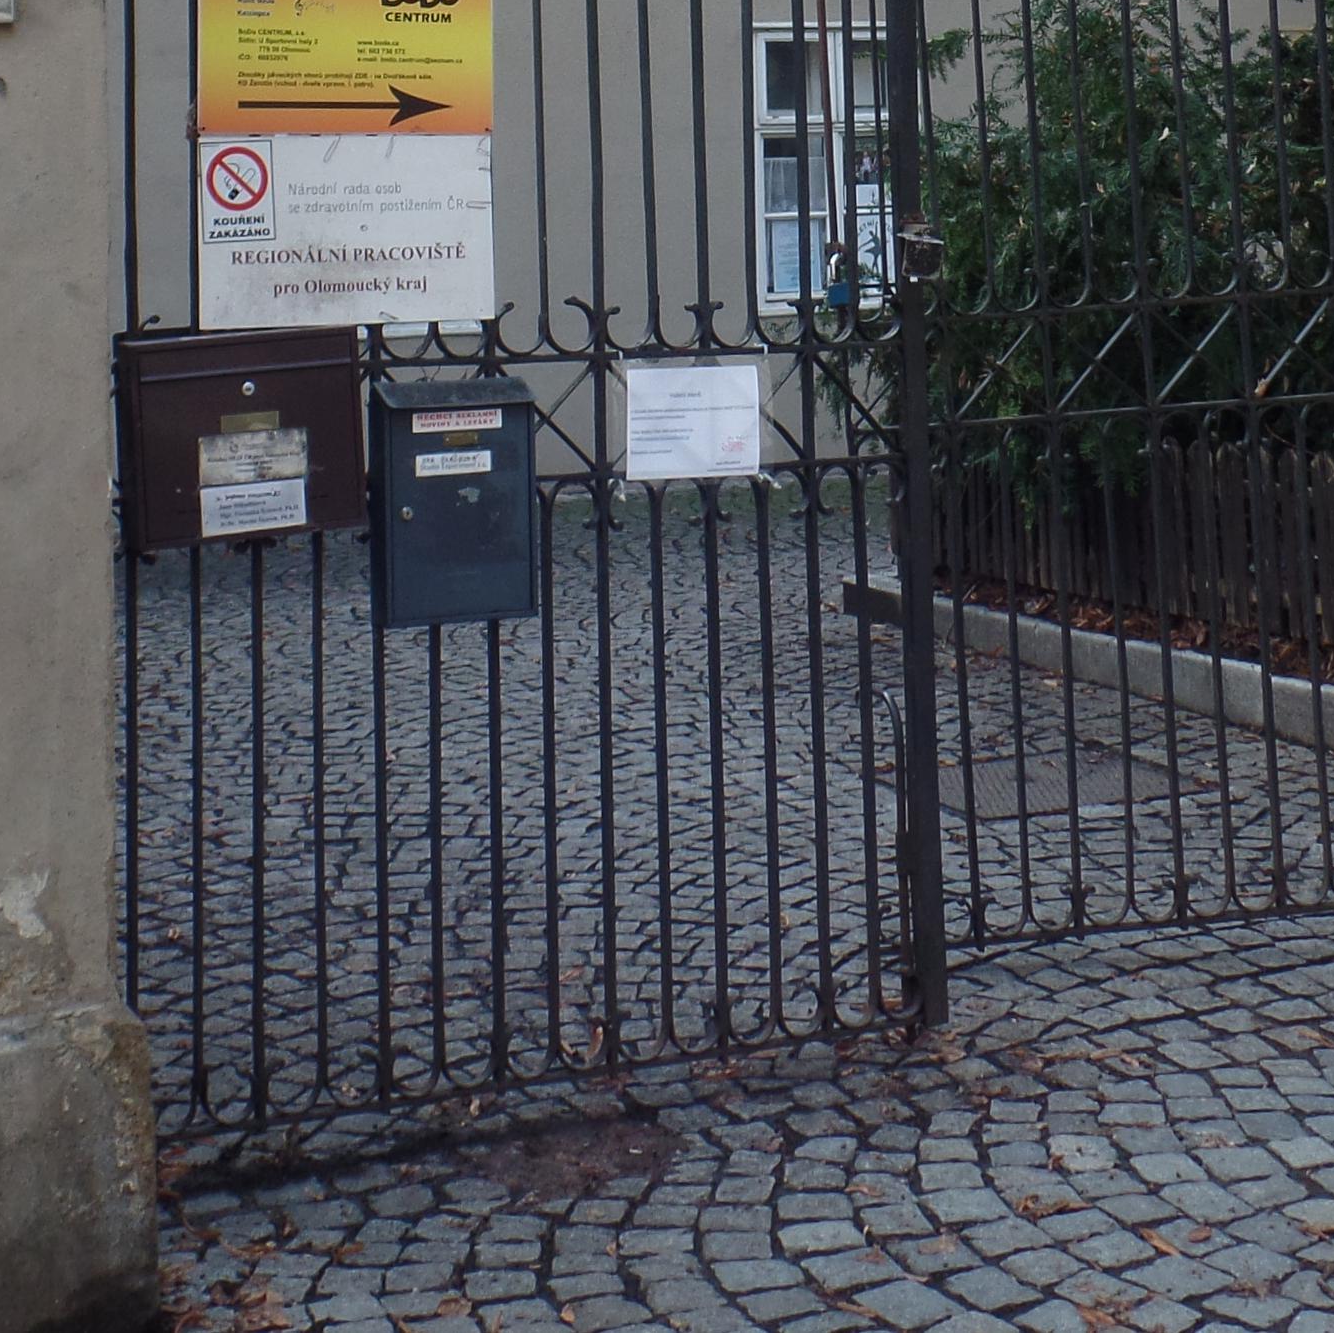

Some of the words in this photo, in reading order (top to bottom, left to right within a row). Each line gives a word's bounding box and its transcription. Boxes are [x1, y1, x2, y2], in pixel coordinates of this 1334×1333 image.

[385, 12, 452, 23] CENTRUM
[288, 182, 337, 195] Národní
[344, 183, 370, 195] rada
[375, 182, 402, 194] osob
[288, 204, 300, 213] se
[305, 200, 373, 213] zdravotním
[380, 198, 442, 214] postižením
[447, 195, 465, 210] ČR
[213, 214, 265, 226] KOUŘENÍ
[231, 244, 347, 265] REGIONÁLNÍ
[353, 241, 466, 262] PRACOVIŠTĚ
[273, 284, 300, 298] pro
[304, 276, 390, 295] Olomoucký
[396, 275, 427, 293] kraj
